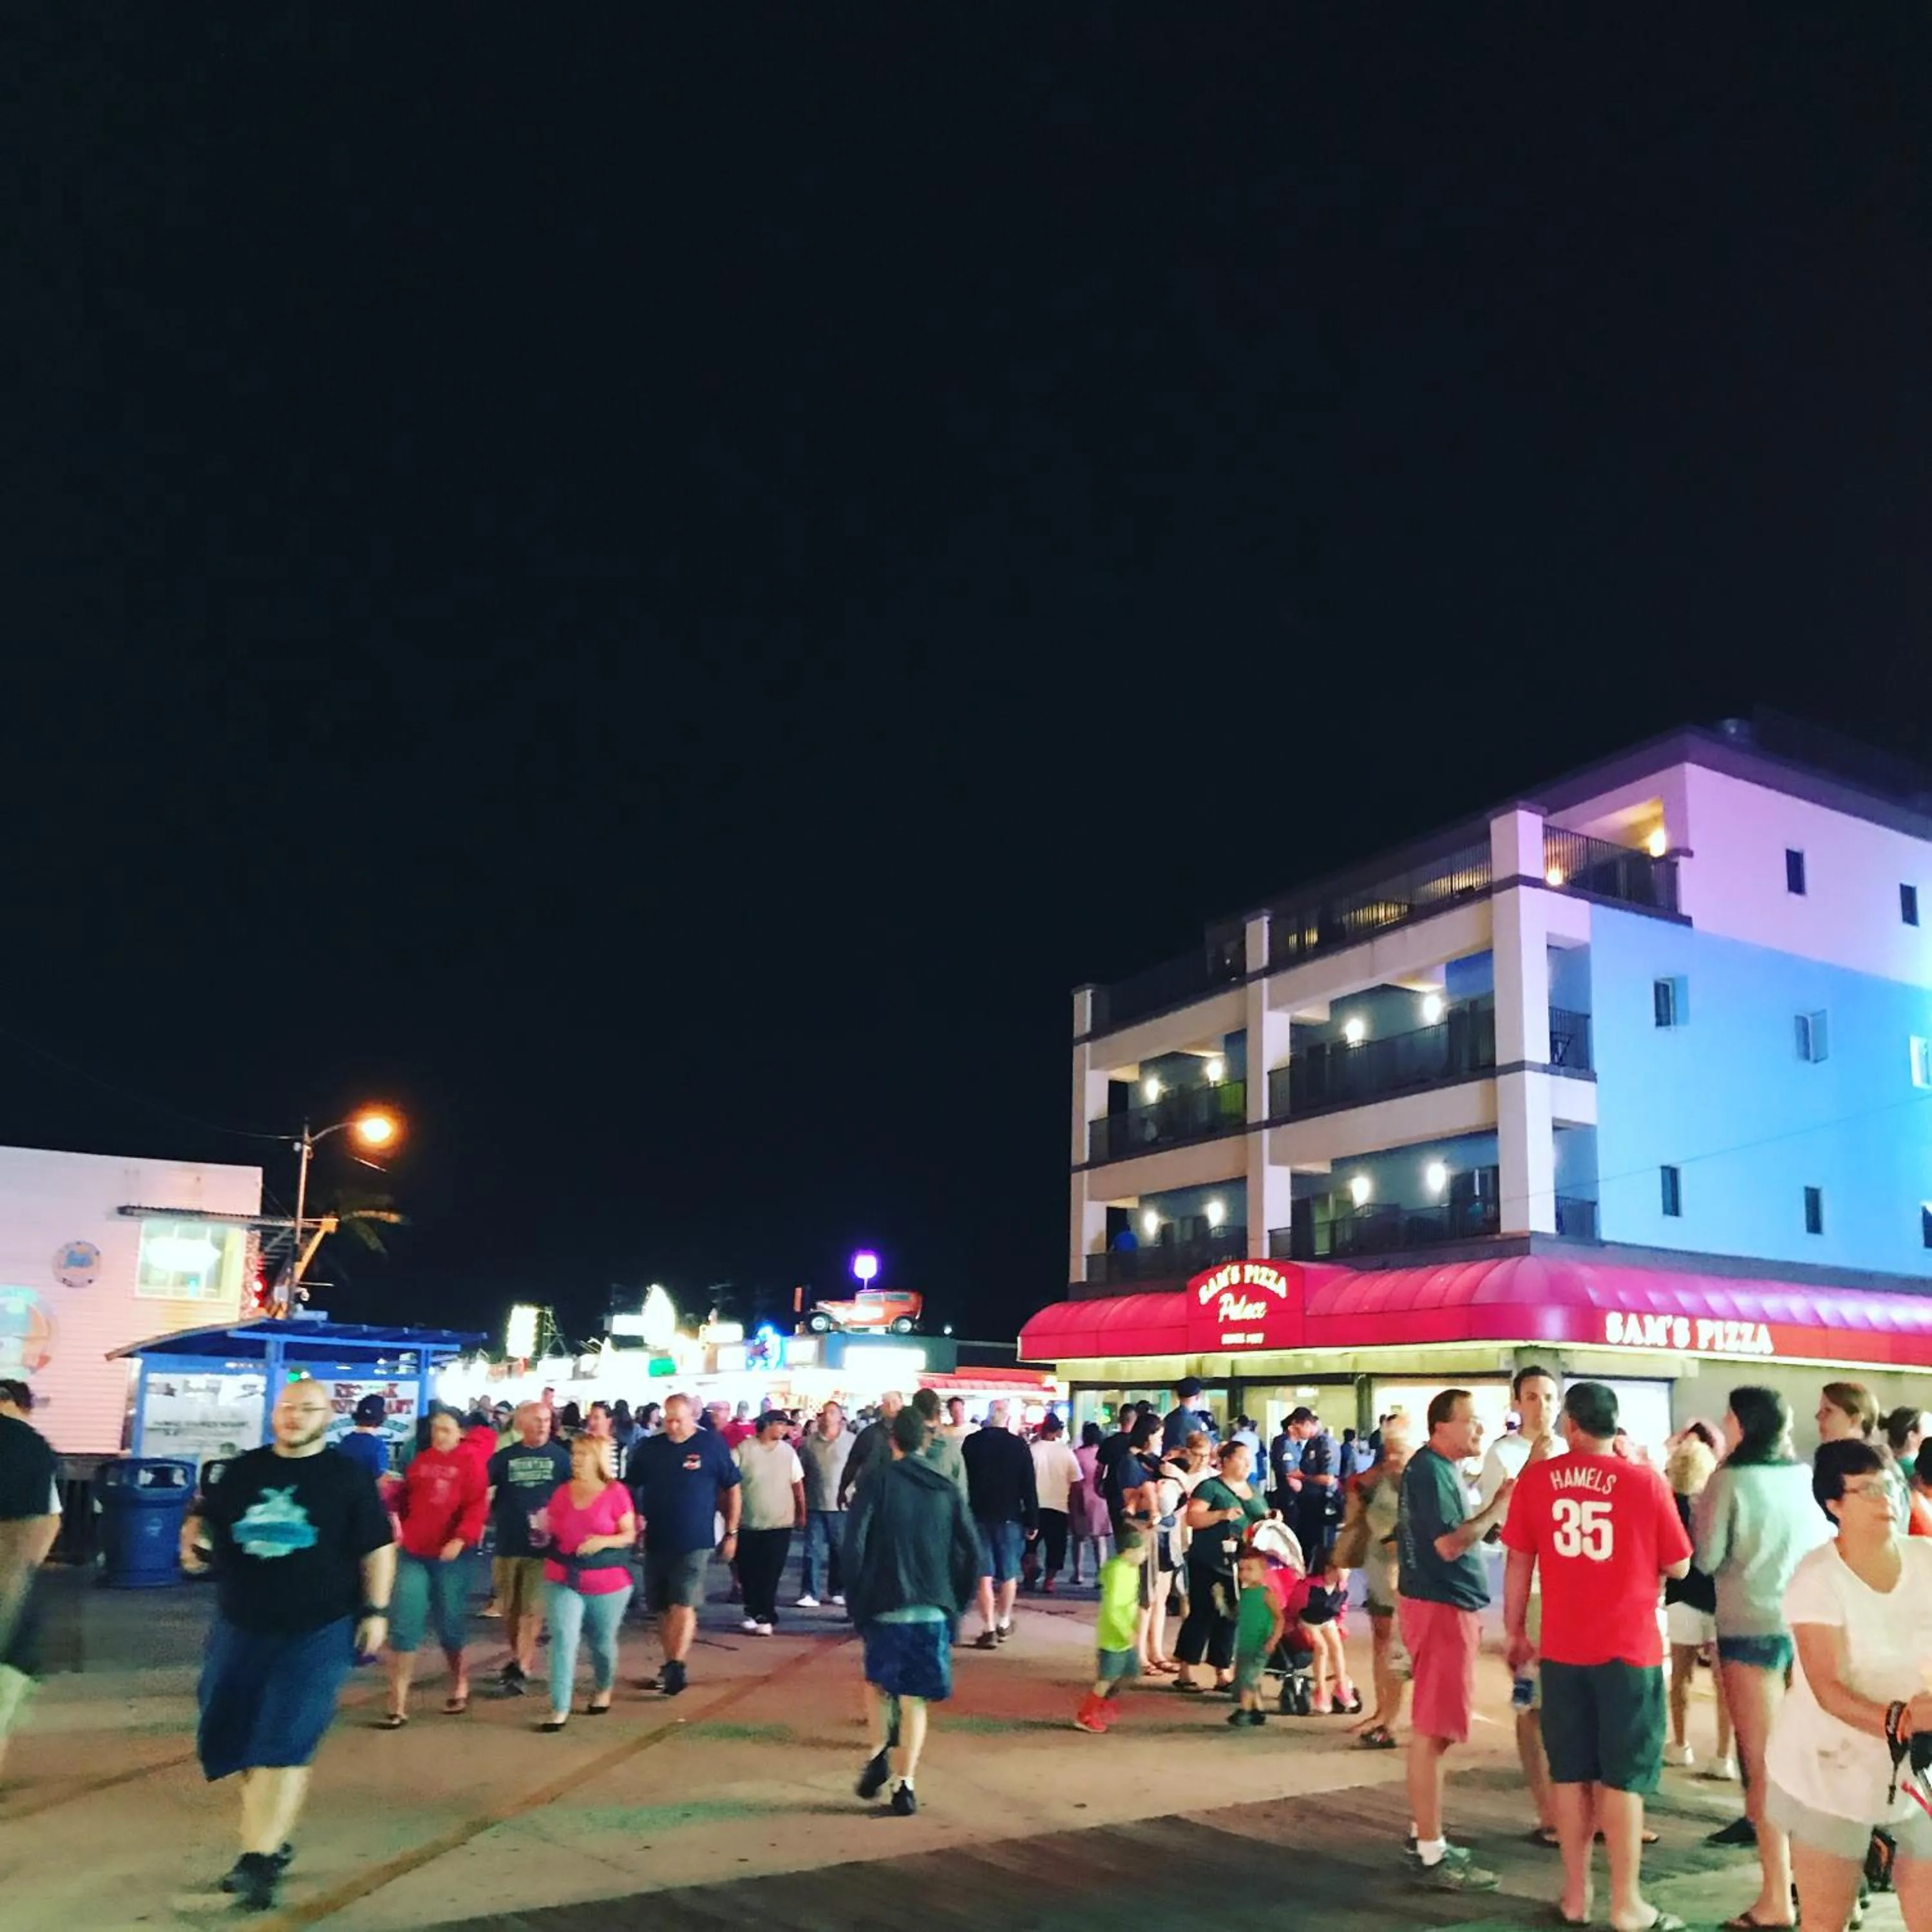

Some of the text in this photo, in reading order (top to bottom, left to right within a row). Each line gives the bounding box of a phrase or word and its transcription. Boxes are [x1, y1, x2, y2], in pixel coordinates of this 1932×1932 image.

[1198, 1264, 1287, 1305] SAM'S PIZZA
[1218, 1293, 1267, 1323] Palace
[1605, 1311, 1774, 1354] SAM'S PIZZA
[1550, 1466, 1617, 1495] HAMELS
[1552, 1498, 1613, 1561] 35
